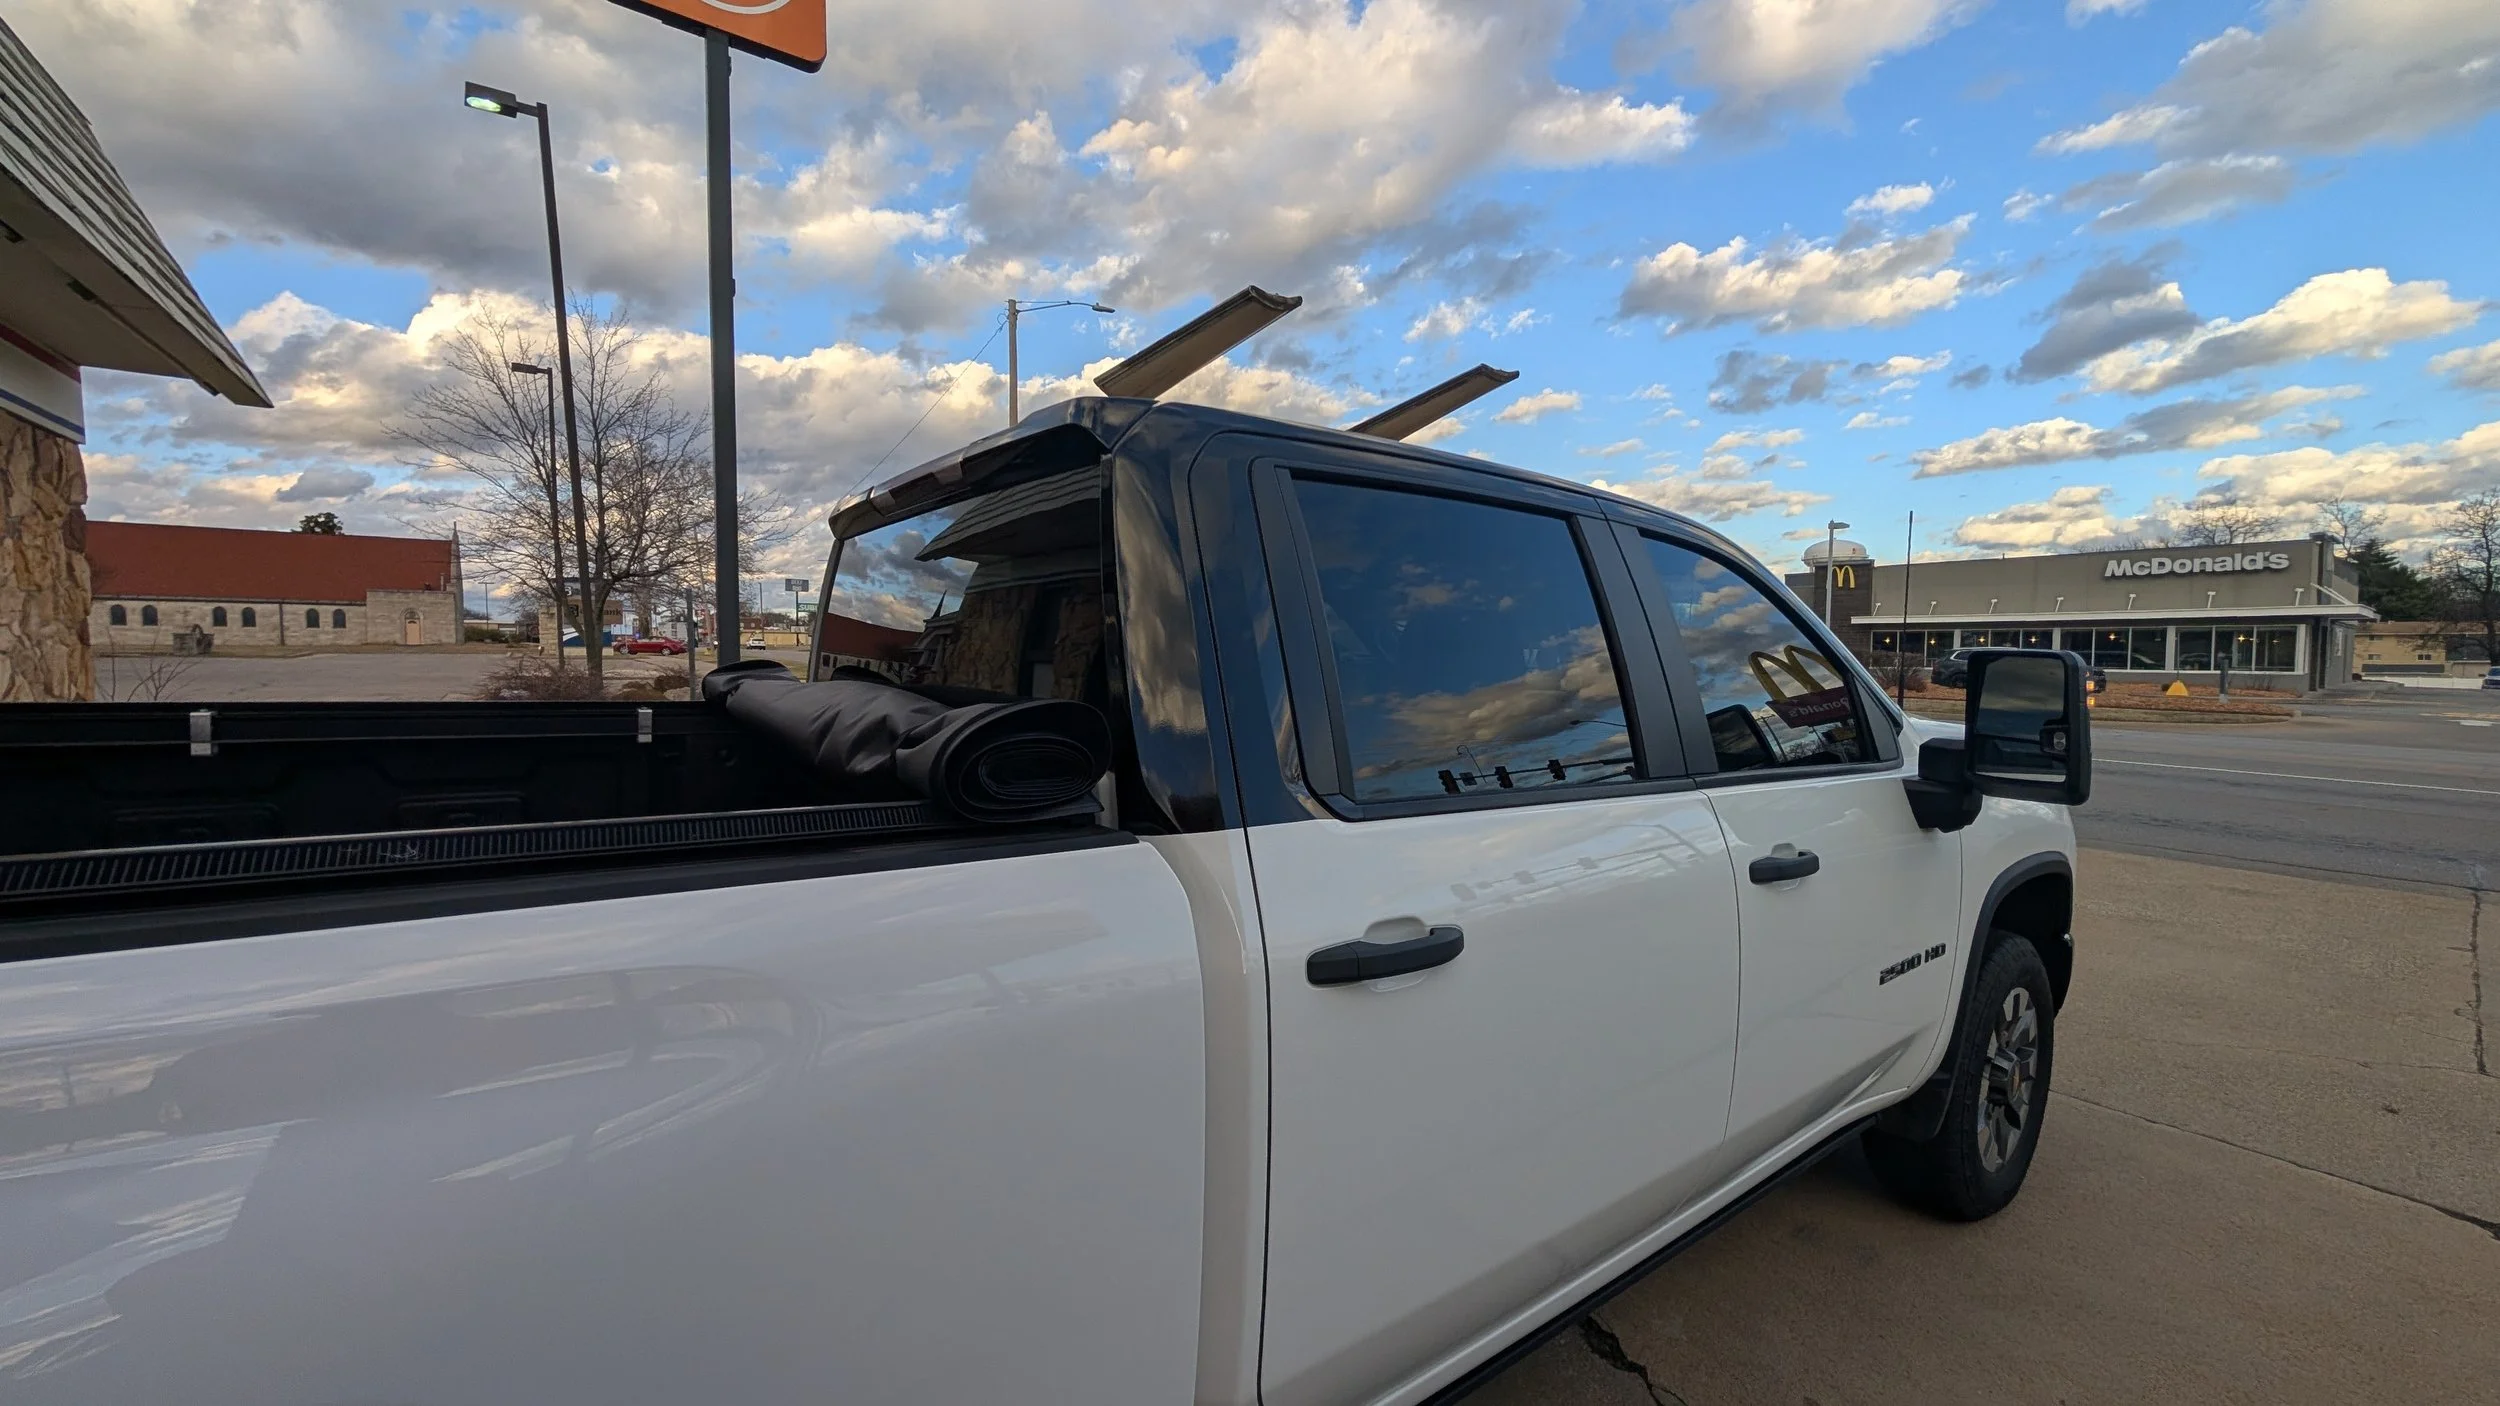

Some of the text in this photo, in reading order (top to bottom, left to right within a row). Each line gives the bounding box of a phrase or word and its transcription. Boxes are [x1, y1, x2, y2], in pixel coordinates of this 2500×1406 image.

[2104, 551, 2290, 577] McDonald's
[1879, 942, 1946, 986] 2500 HD
